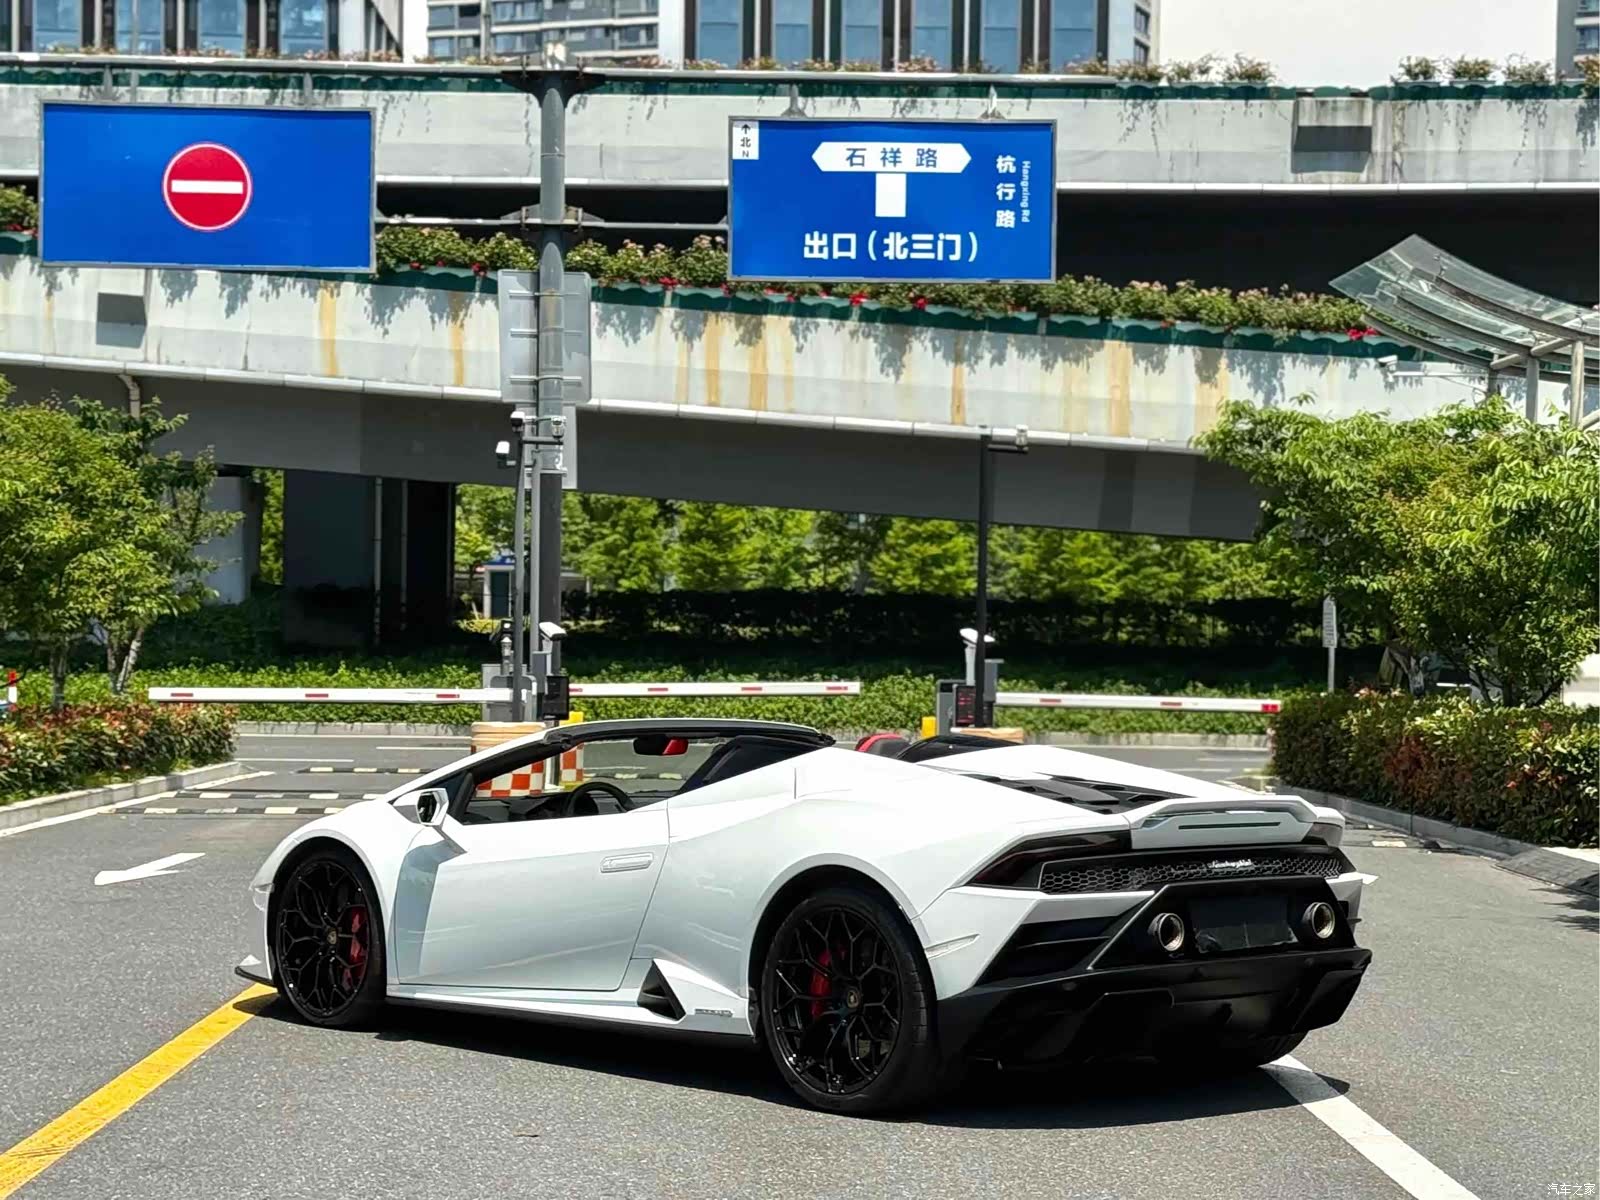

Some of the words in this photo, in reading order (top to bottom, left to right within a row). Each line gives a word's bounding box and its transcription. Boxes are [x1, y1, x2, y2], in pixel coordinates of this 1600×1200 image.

[740, 137, 751, 148] 北
[742, 150, 749, 158] N
[846, 148, 938, 168] 石祥路
[995, 155, 1016, 228] 杭行路
[1020, 160, 1031, 208] Hangxing
[1021, 209, 1031, 223] Rd
[803, 230, 978, 262] 出口（北三门）
